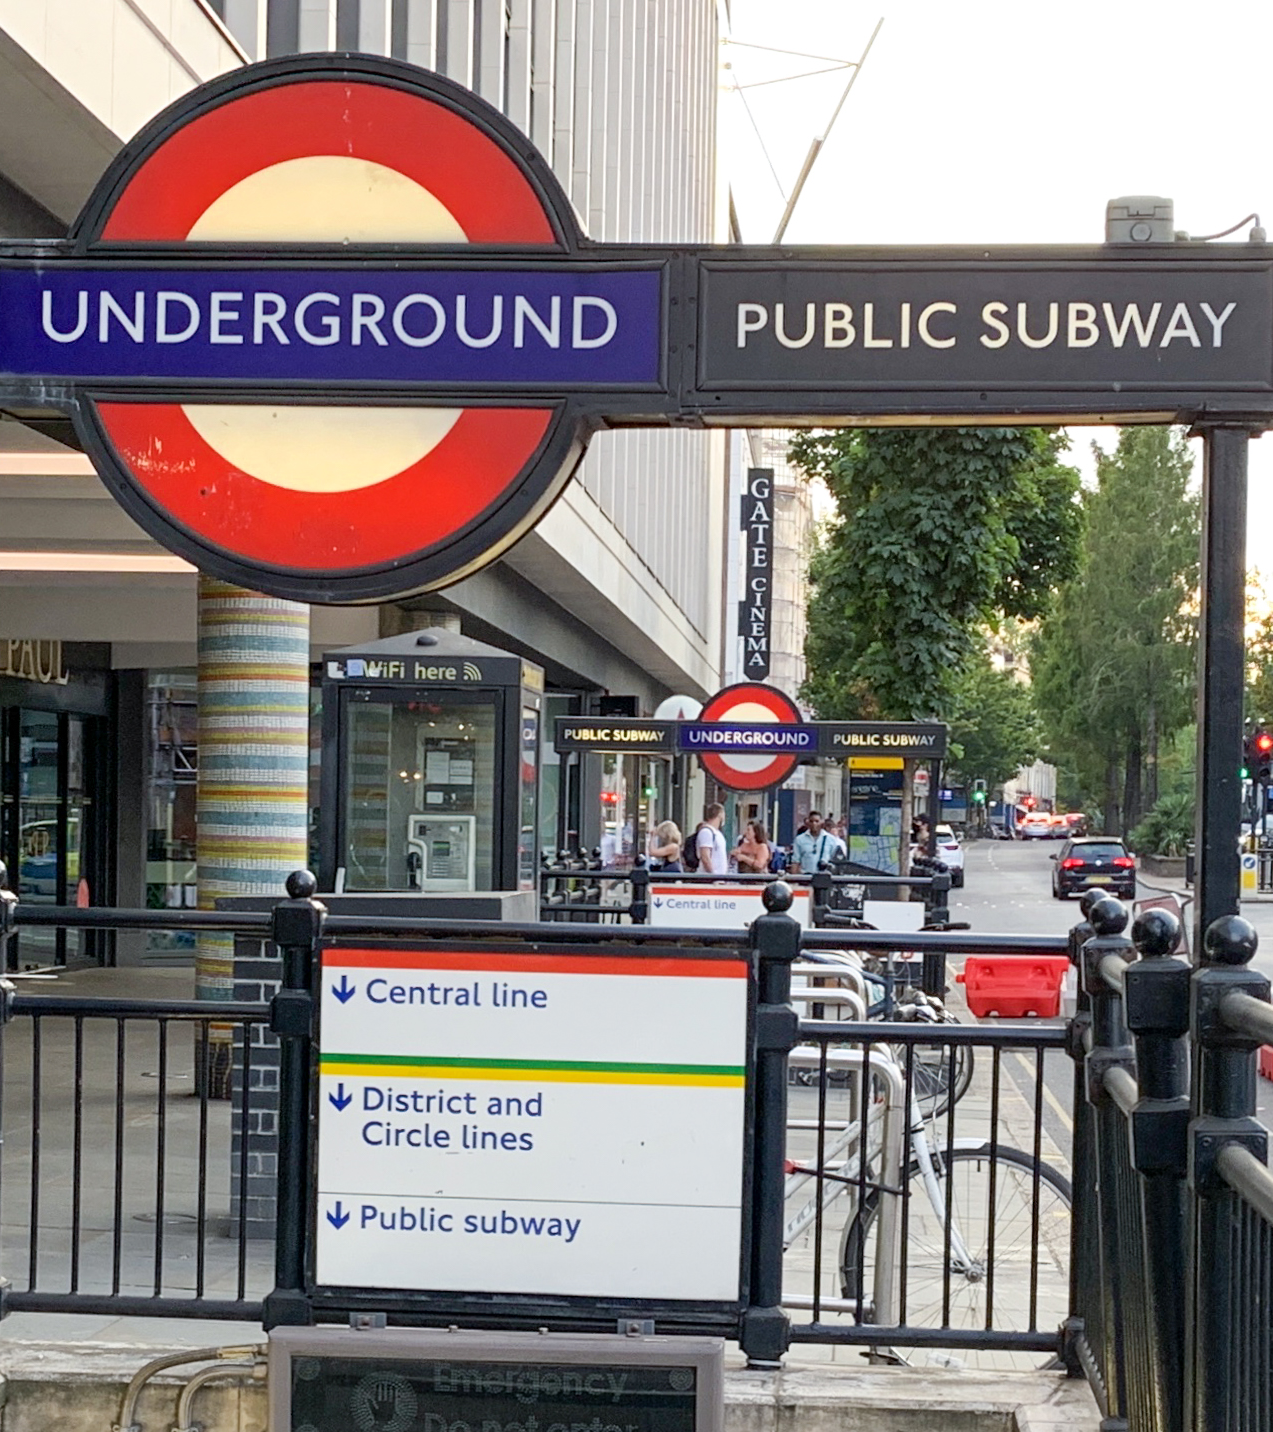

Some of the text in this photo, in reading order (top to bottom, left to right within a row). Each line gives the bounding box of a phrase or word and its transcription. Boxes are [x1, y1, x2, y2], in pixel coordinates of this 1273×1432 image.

[41, 290, 618, 350] UNDERGROUND
[737, 302, 1237, 349] PUBLIC SUBWAY
[747, 478, 770, 666] GATE CINEMA
[6, 640, 69, 685] PAUL
[362, 661, 457, 680] WiFi here
[564, 729, 666, 742] PUBLIC SUBWAY
[689, 730, 810, 745] UNDERGROUND
[833, 734, 936, 746] PUBLIC SUBWAY
[666, 898, 736, 910] Central line
[365, 979, 548, 1009] Central line
[363, 1087, 543, 1117] District and
[362, 1120, 534, 1151] Circle lines
[360, 1205, 581, 1243] Public subway
[433, 1362, 629, 1403] Emergency
